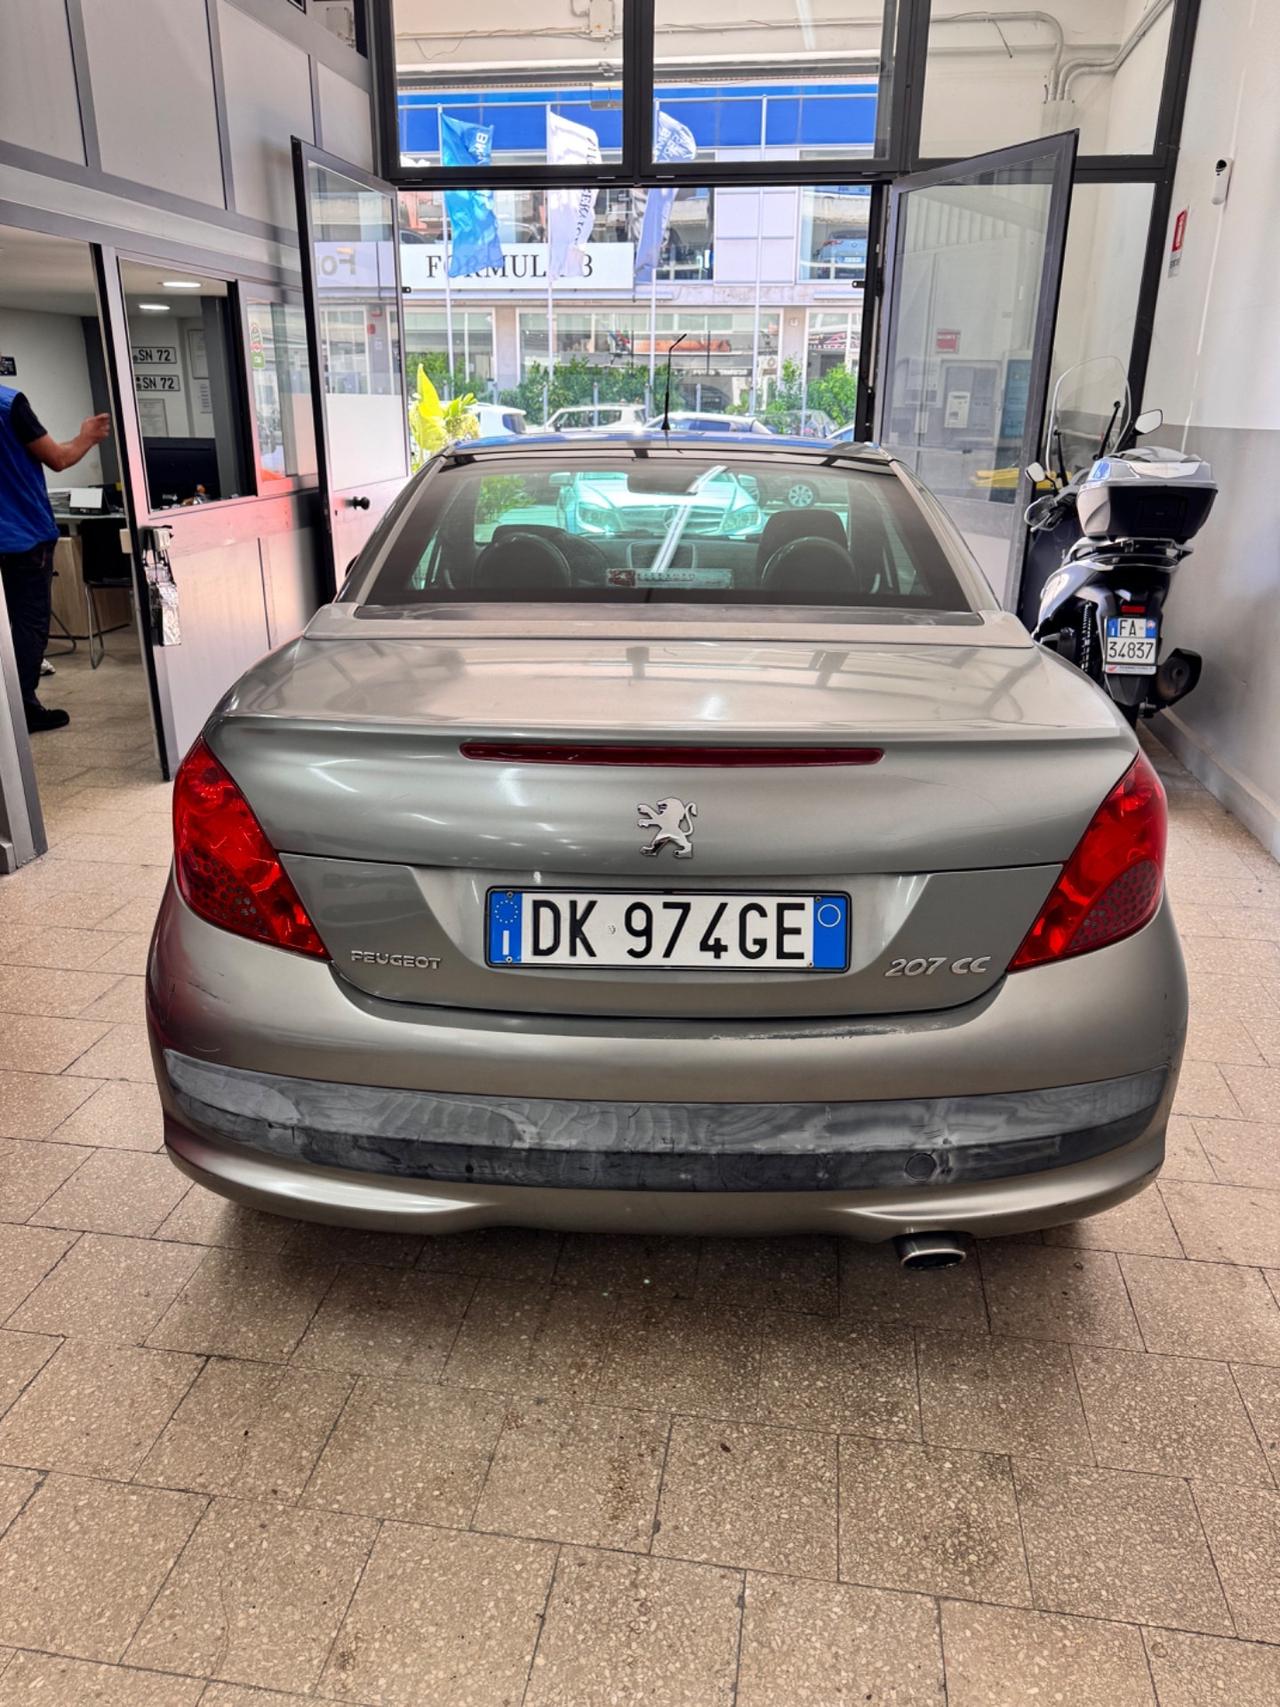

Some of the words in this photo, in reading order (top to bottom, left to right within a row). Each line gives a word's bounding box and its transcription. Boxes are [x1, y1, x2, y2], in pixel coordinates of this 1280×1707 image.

[426, 255, 567, 277] FRMUL
[157, 349, 171, 361] 72
[160, 377, 175, 389] 72
[1119, 619, 1136, 636] FA
[1108, 641, 1154, 659] 34837
[532, 900, 598, 957] DK
[624, 901, 806, 960] 974GE
[351, 950, 441, 970] PEUGEOT
[884, 957, 948, 977] 207
[951, 956, 992, 974] CC
